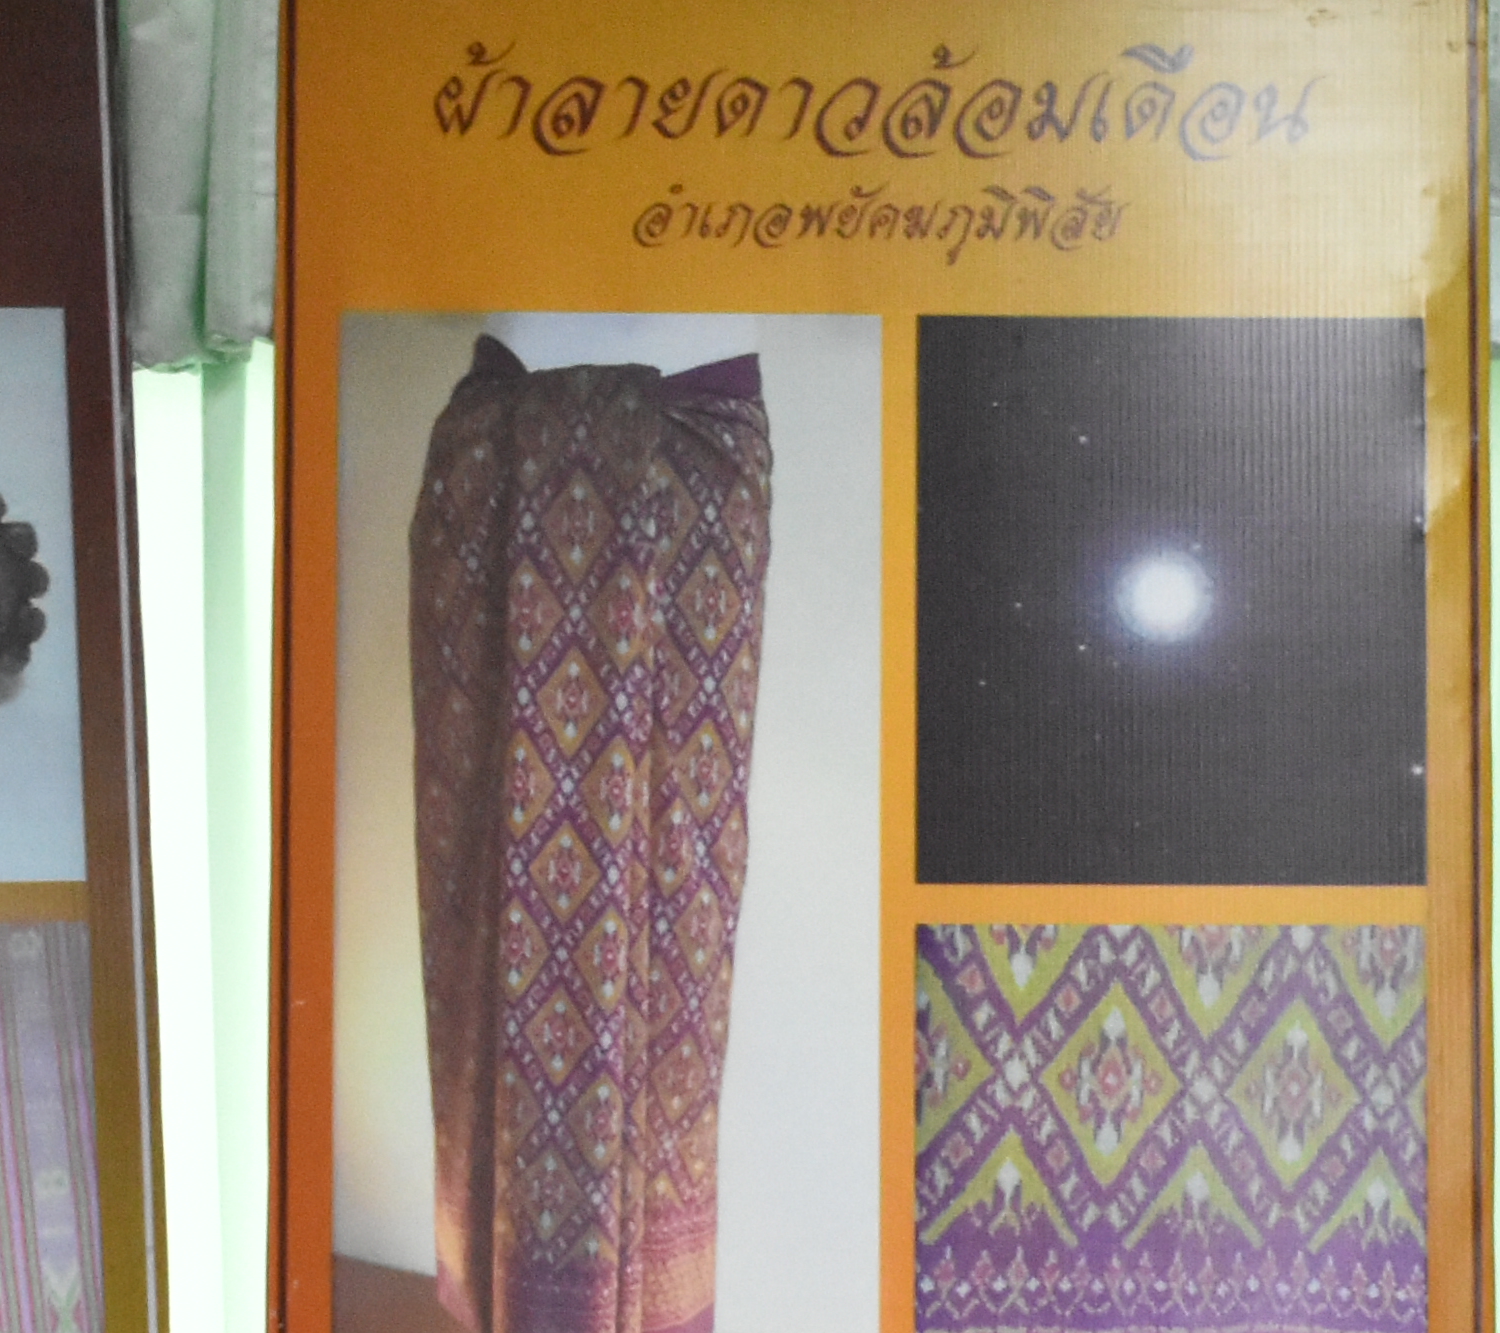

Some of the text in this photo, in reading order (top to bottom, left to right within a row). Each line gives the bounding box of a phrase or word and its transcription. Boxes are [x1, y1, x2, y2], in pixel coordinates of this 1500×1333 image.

[433, 41, 1328, 160] ผ้าลายดาวล้อมเดือน
